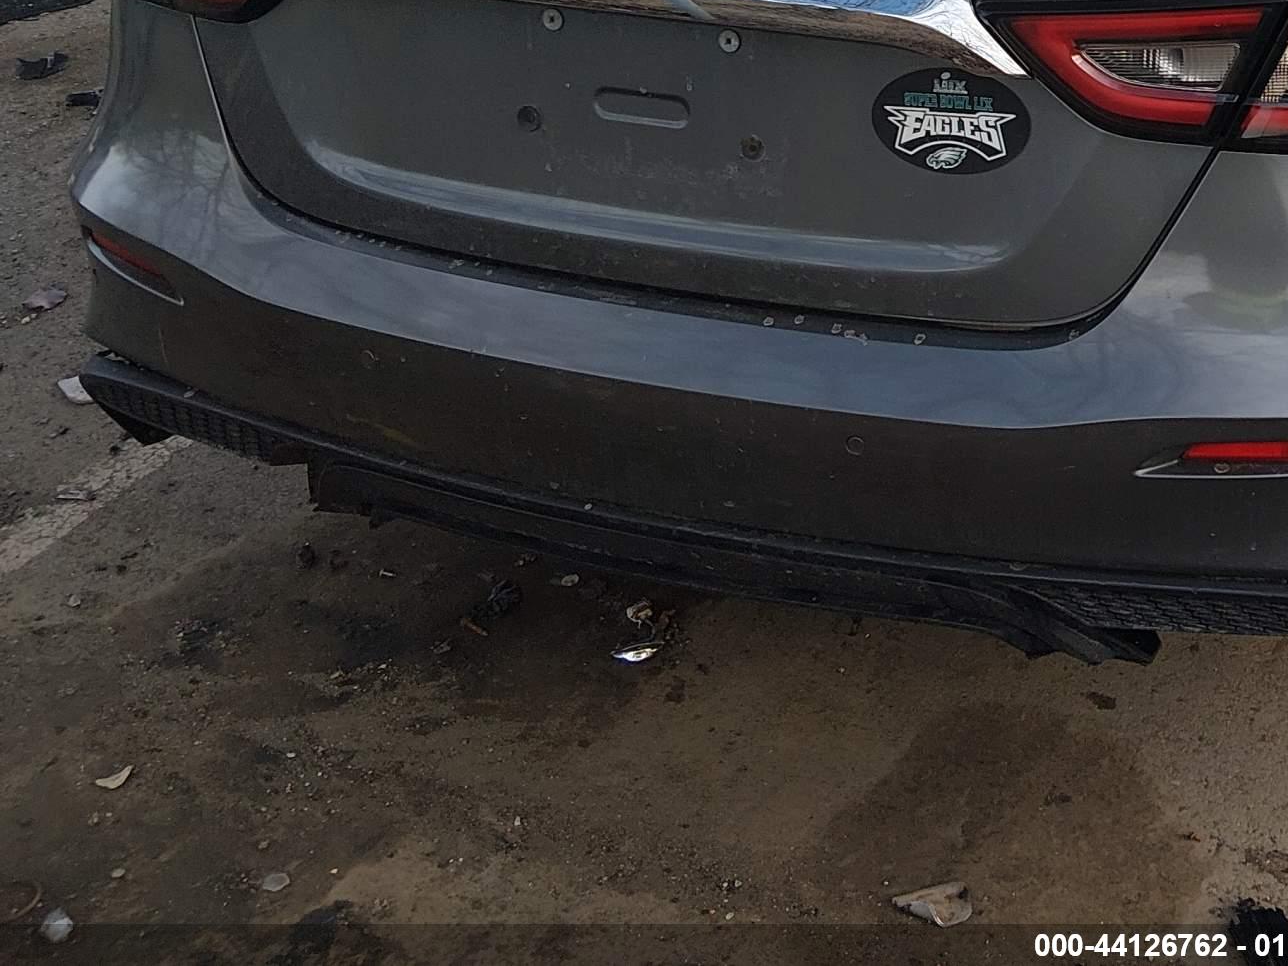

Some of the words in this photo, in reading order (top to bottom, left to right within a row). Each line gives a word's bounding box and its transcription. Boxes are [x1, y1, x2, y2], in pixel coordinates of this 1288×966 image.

[903, 92, 938, 108] SUPER
[940, 94, 972, 110] BOWL
[973, 96, 994, 112] LIX
[900, 109, 1002, 152] EAGLES
